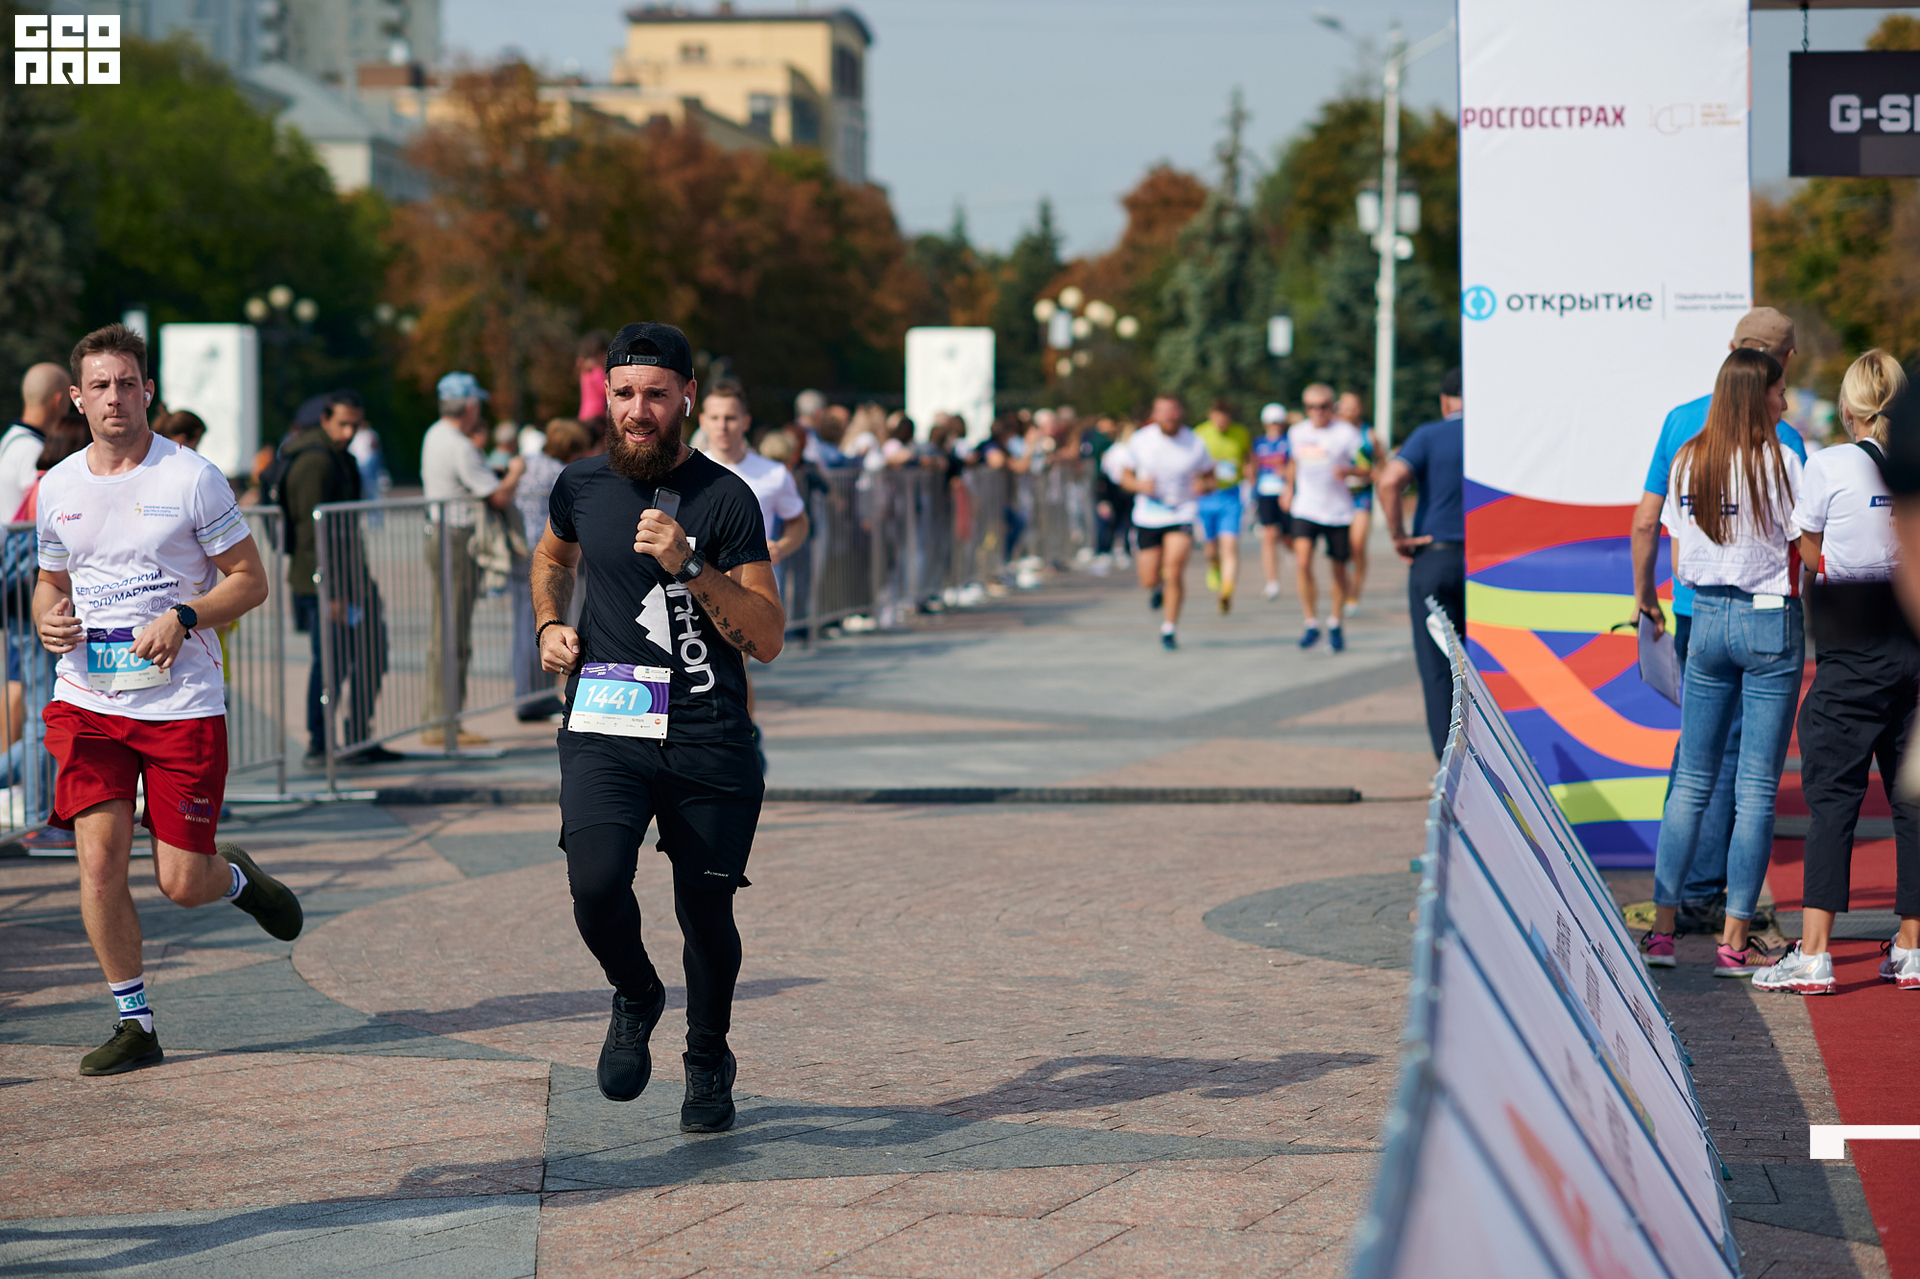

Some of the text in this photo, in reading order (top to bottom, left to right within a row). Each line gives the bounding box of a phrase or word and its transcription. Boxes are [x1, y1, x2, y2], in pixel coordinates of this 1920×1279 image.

[1463, 105, 1625, 129] РОСГОССТРАХ
[1829, 94, 1920, 133] G-S
[1506, 292, 1653, 317] открытие
[584, 684, 640, 711] 1441
